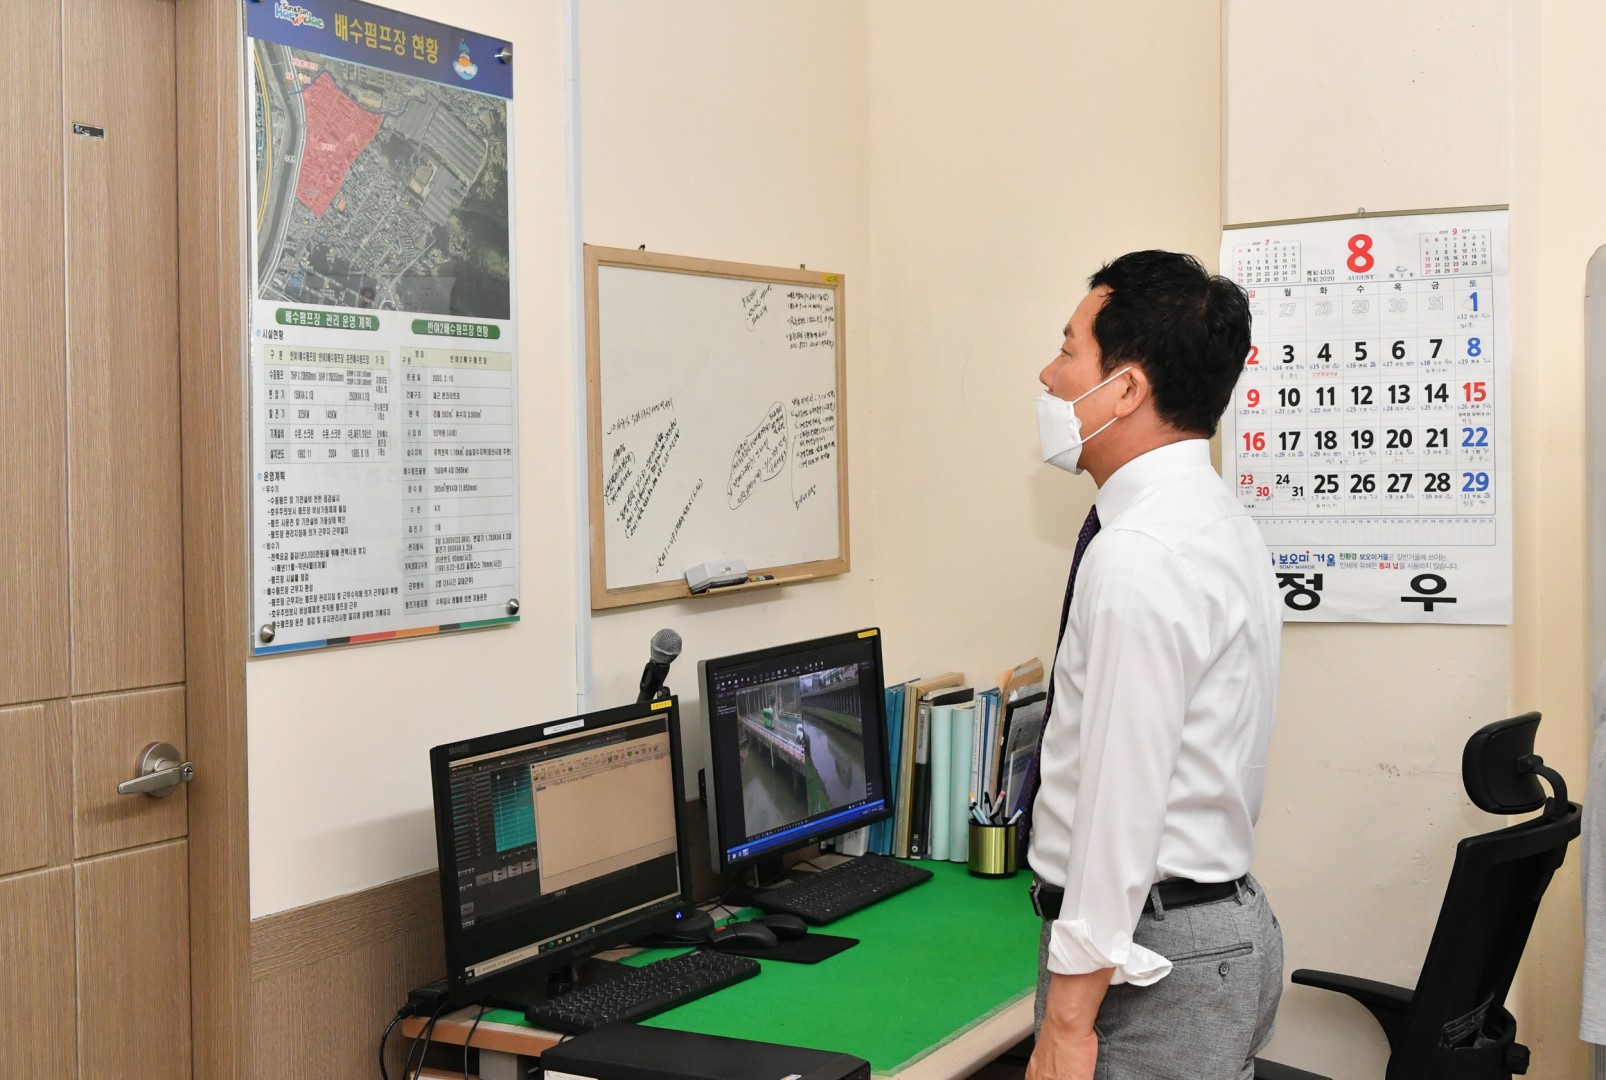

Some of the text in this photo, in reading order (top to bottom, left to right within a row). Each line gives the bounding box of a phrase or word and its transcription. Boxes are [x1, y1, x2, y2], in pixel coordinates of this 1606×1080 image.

[335, 13, 438, 64] 배수펌프장 현황
[1347, 234, 1374, 273] 8
[1284, 288, 1291, 296] 월
[1320, 286, 1327, 294] 화
[1357, 285, 1364, 293] 수
[1394, 283, 1402, 291] 목
[1432, 281, 1439, 290] 금
[1280, 292, 1478, 317] 27 28 29 30 31 1
[285, 310, 371, 329] 배수펌프장 관리 운영 계획
[428, 322, 488, 337] 반여2배수펌프장 현황
[263, 330, 284, 340] 시설현황
[1247, 338, 1481, 365] 2 3 4 5 6 7 8
[1247, 382, 1486, 407] 9 10 11 12 13 14 15
[1243, 427, 1488, 451] 16 17 18 19 20 21 22
[264, 472, 285, 481] 운영계획
[1240, 472, 1488, 493] 23 24 25 26 27 28 29
[1256, 486, 1303, 496] 30 31
[1279, 551, 1335, 567] 보오미 거울
[1360, 553, 1393, 561] 보오미거울은
[1276, 573, 1457, 611] 정 우
